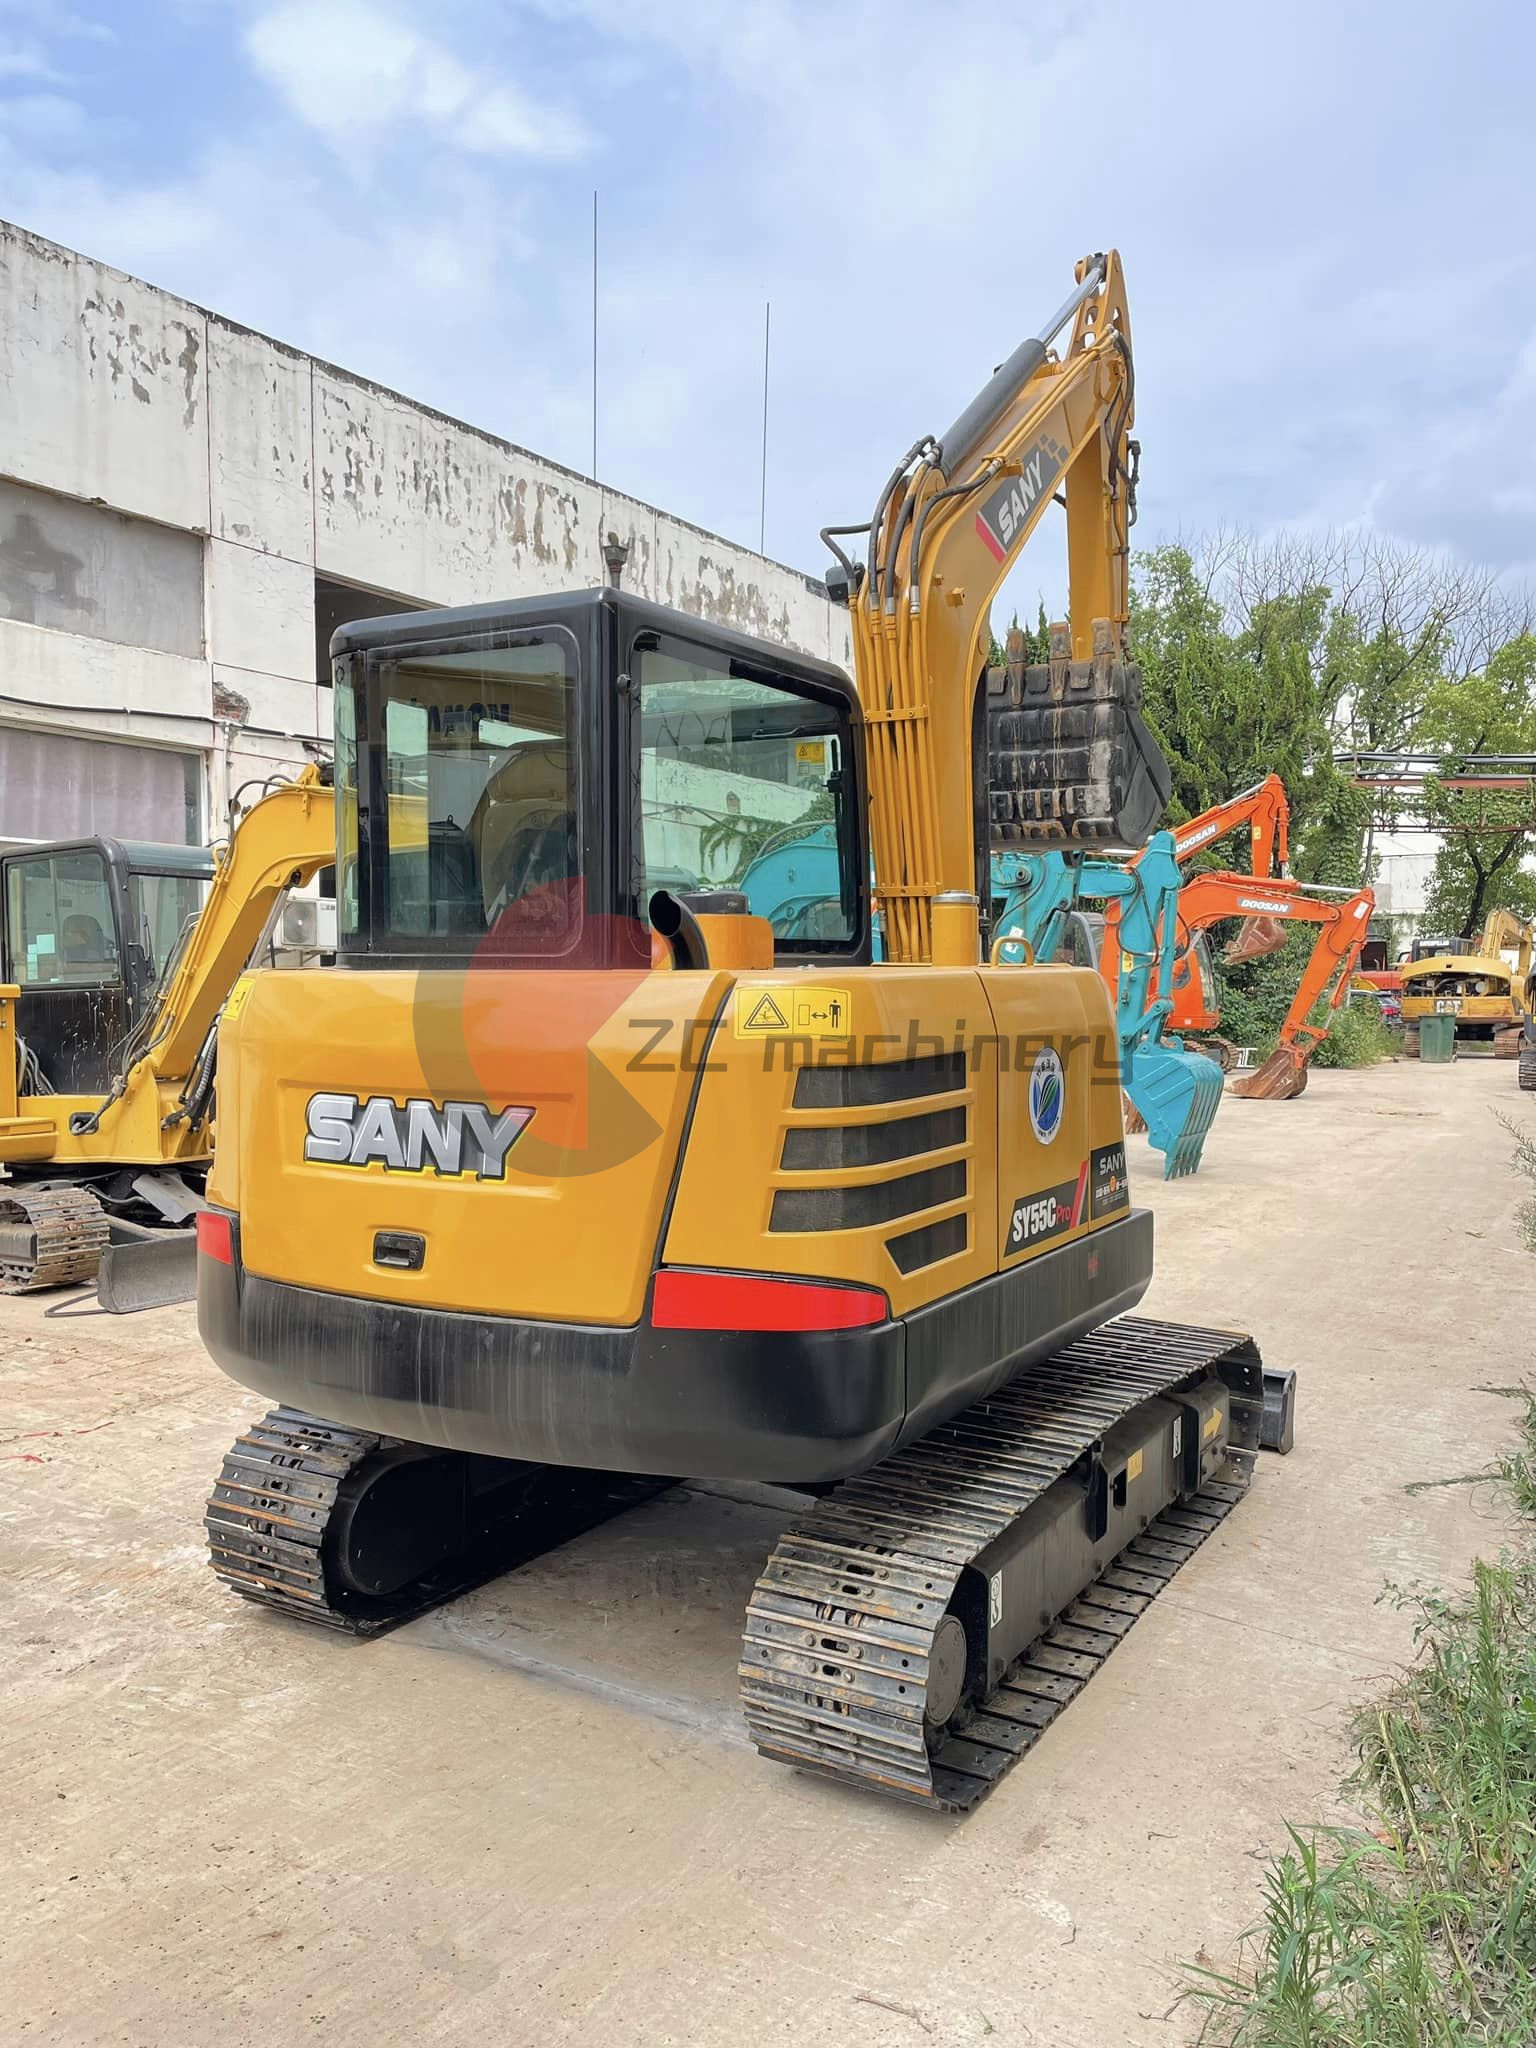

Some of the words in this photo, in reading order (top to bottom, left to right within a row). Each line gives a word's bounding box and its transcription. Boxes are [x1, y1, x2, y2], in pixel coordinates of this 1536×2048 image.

[998, 451, 1043, 545] SANY
[1175, 824, 1216, 853] DOOSAN
[1240, 898, 1290, 914] DOOSAN
[1436, 1000, 1462, 1014] CAT
[304, 1091, 537, 1181] SANY
[1099, 1151, 1125, 1176] SANY
[1012, 1196, 1057, 1242] SY55C
